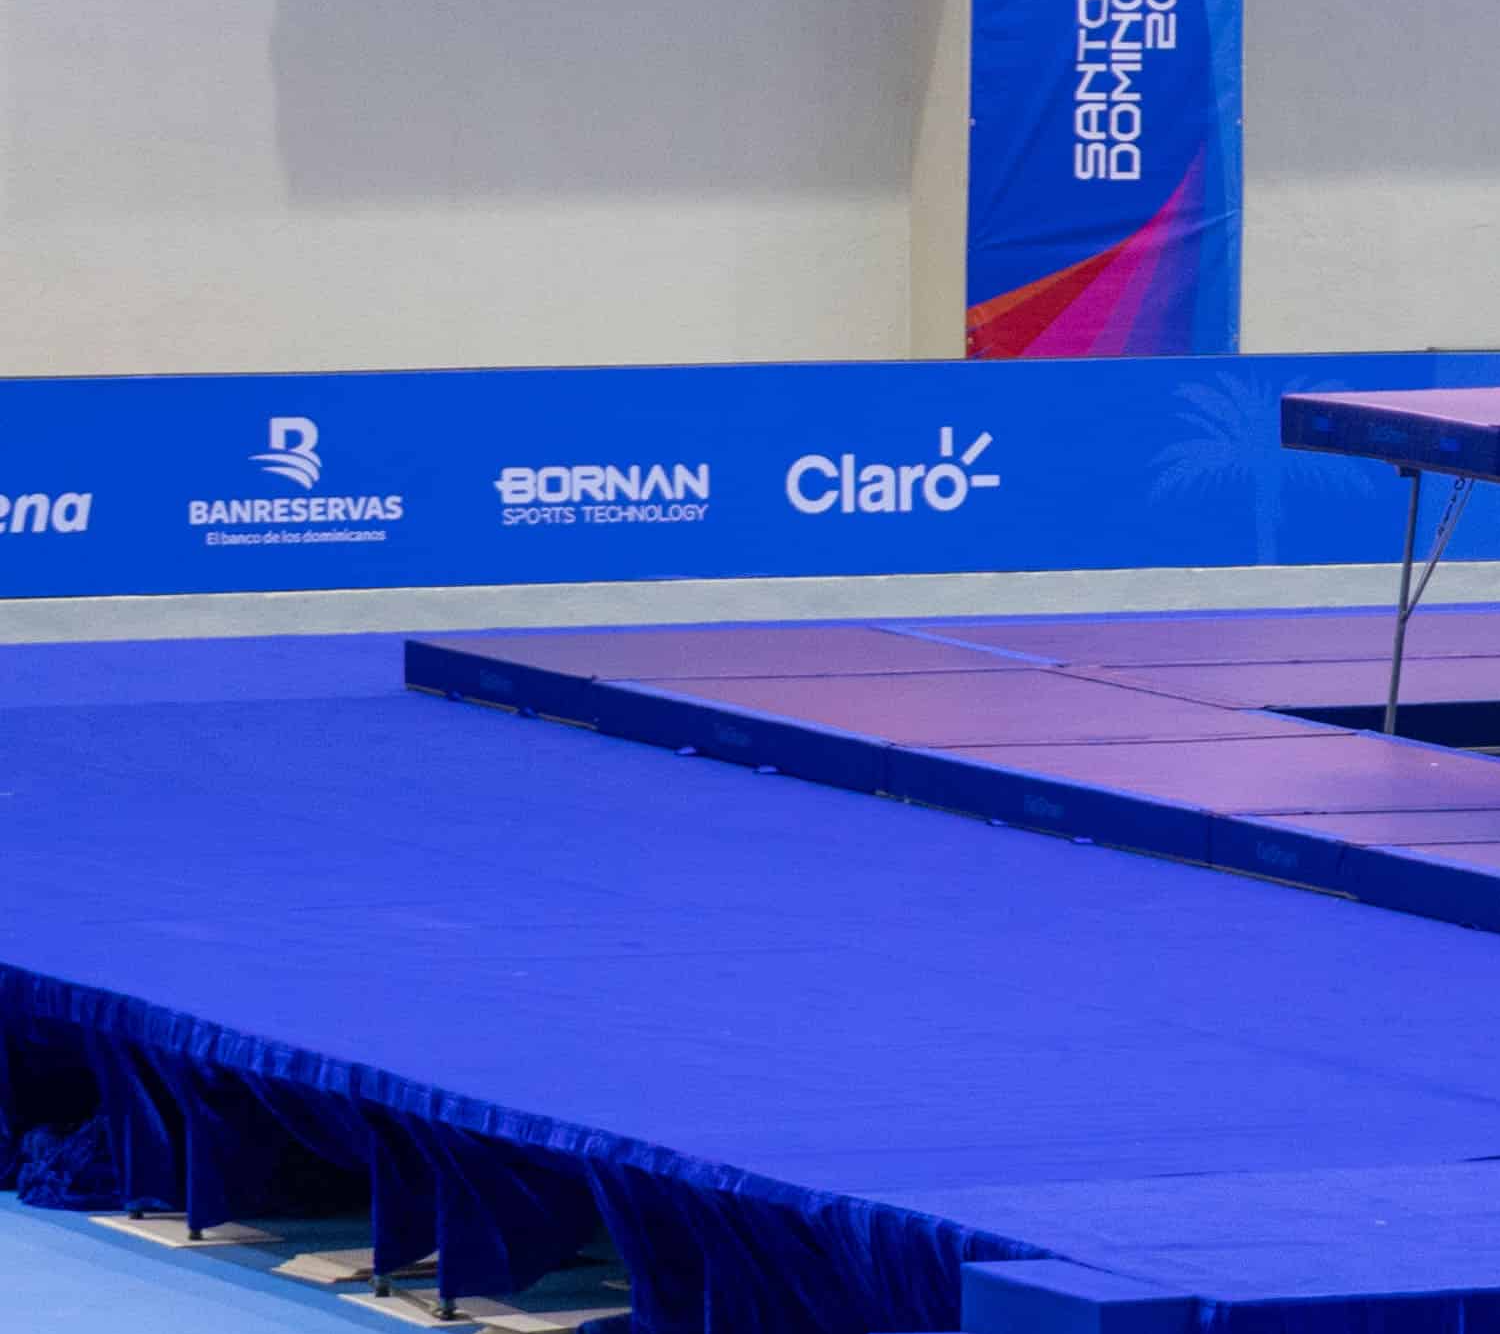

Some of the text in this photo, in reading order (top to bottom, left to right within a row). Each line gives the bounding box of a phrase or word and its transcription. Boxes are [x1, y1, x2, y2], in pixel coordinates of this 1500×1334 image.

[495, 464, 709, 504] BORNAN
[786, 454, 969, 515] Claro
[189, 496, 403, 526] BANRESERVAS
[503, 504, 708, 525] SPORTS TECHNOLOGY
[207, 529, 387, 545] El banco de los dominicanos
